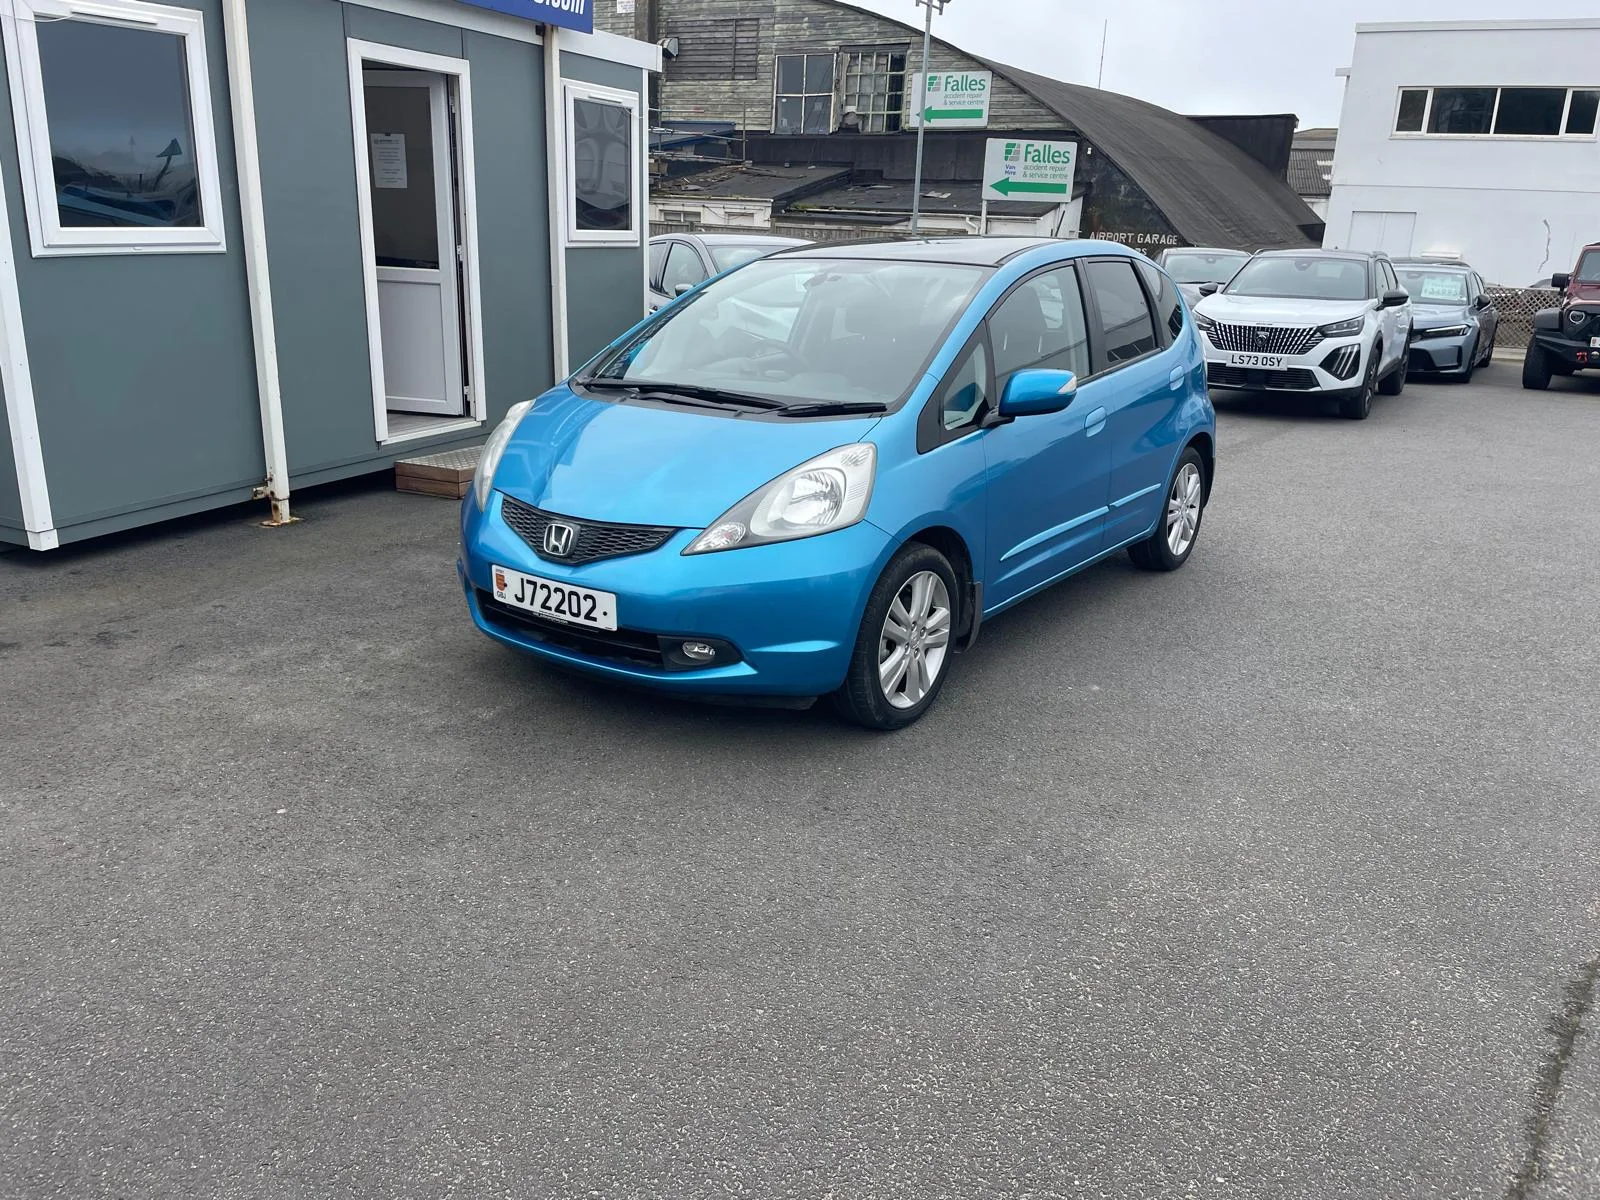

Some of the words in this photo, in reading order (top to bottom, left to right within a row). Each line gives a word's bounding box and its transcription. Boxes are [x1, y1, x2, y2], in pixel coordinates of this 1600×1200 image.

[944, 75, 986, 91] Falles
[1024, 144, 1070, 164] Falles
[1089, 231, 1135, 243] AIRPORT
[1137, 233, 1178, 245] GARAGE
[1231, 354, 1259, 366] LS73
[1261, 356, 1283, 367] OSY
[514, 577, 598, 622] J72202
